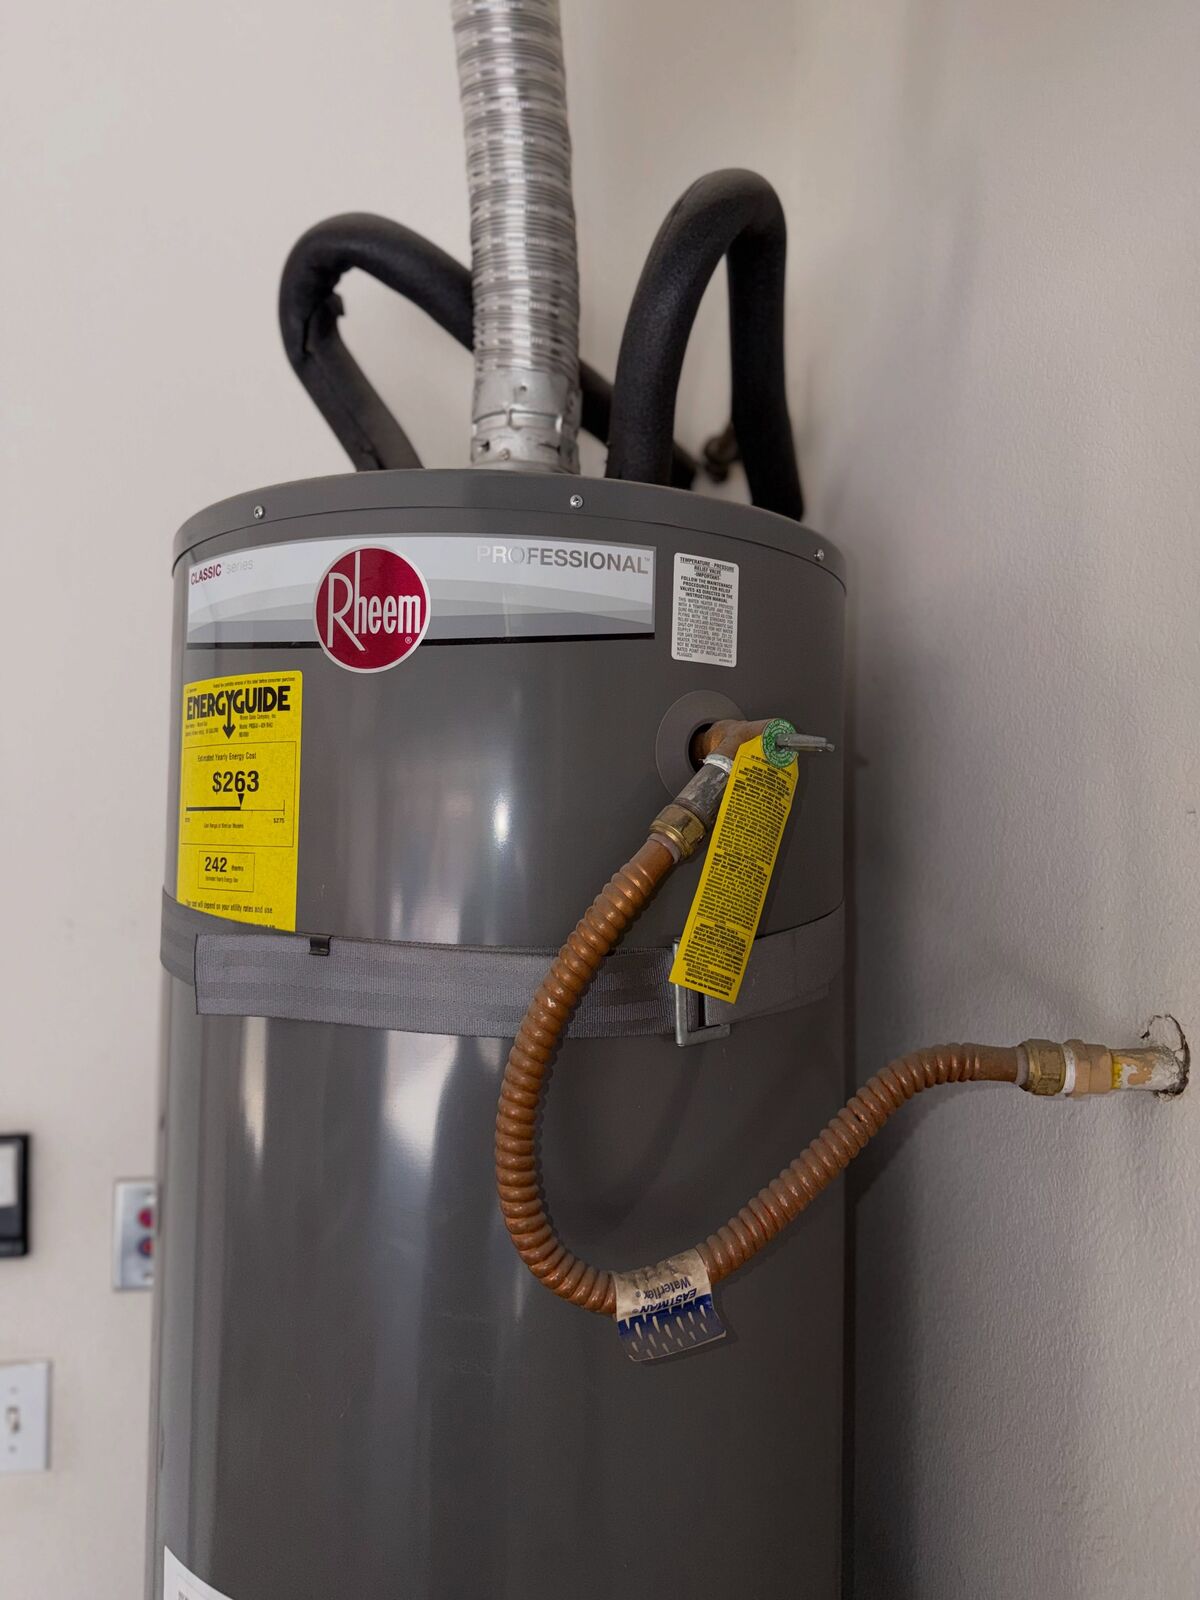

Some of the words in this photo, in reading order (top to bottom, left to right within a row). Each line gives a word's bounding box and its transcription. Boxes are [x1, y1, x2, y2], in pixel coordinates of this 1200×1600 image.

[477, 545, 648, 574] PROFESSIONAL
[191, 564, 222, 585] CLASSIC
[226, 560, 253, 574] series
[328, 551, 420, 651] Rheem
[187, 686, 290, 720] ENERGYGUIDE
[212, 770, 260, 795] $263
[205, 857, 227, 872] 242
[644, 1276, 691, 1299] Waterflex
[640, 1288, 697, 1313] EASTMAN
